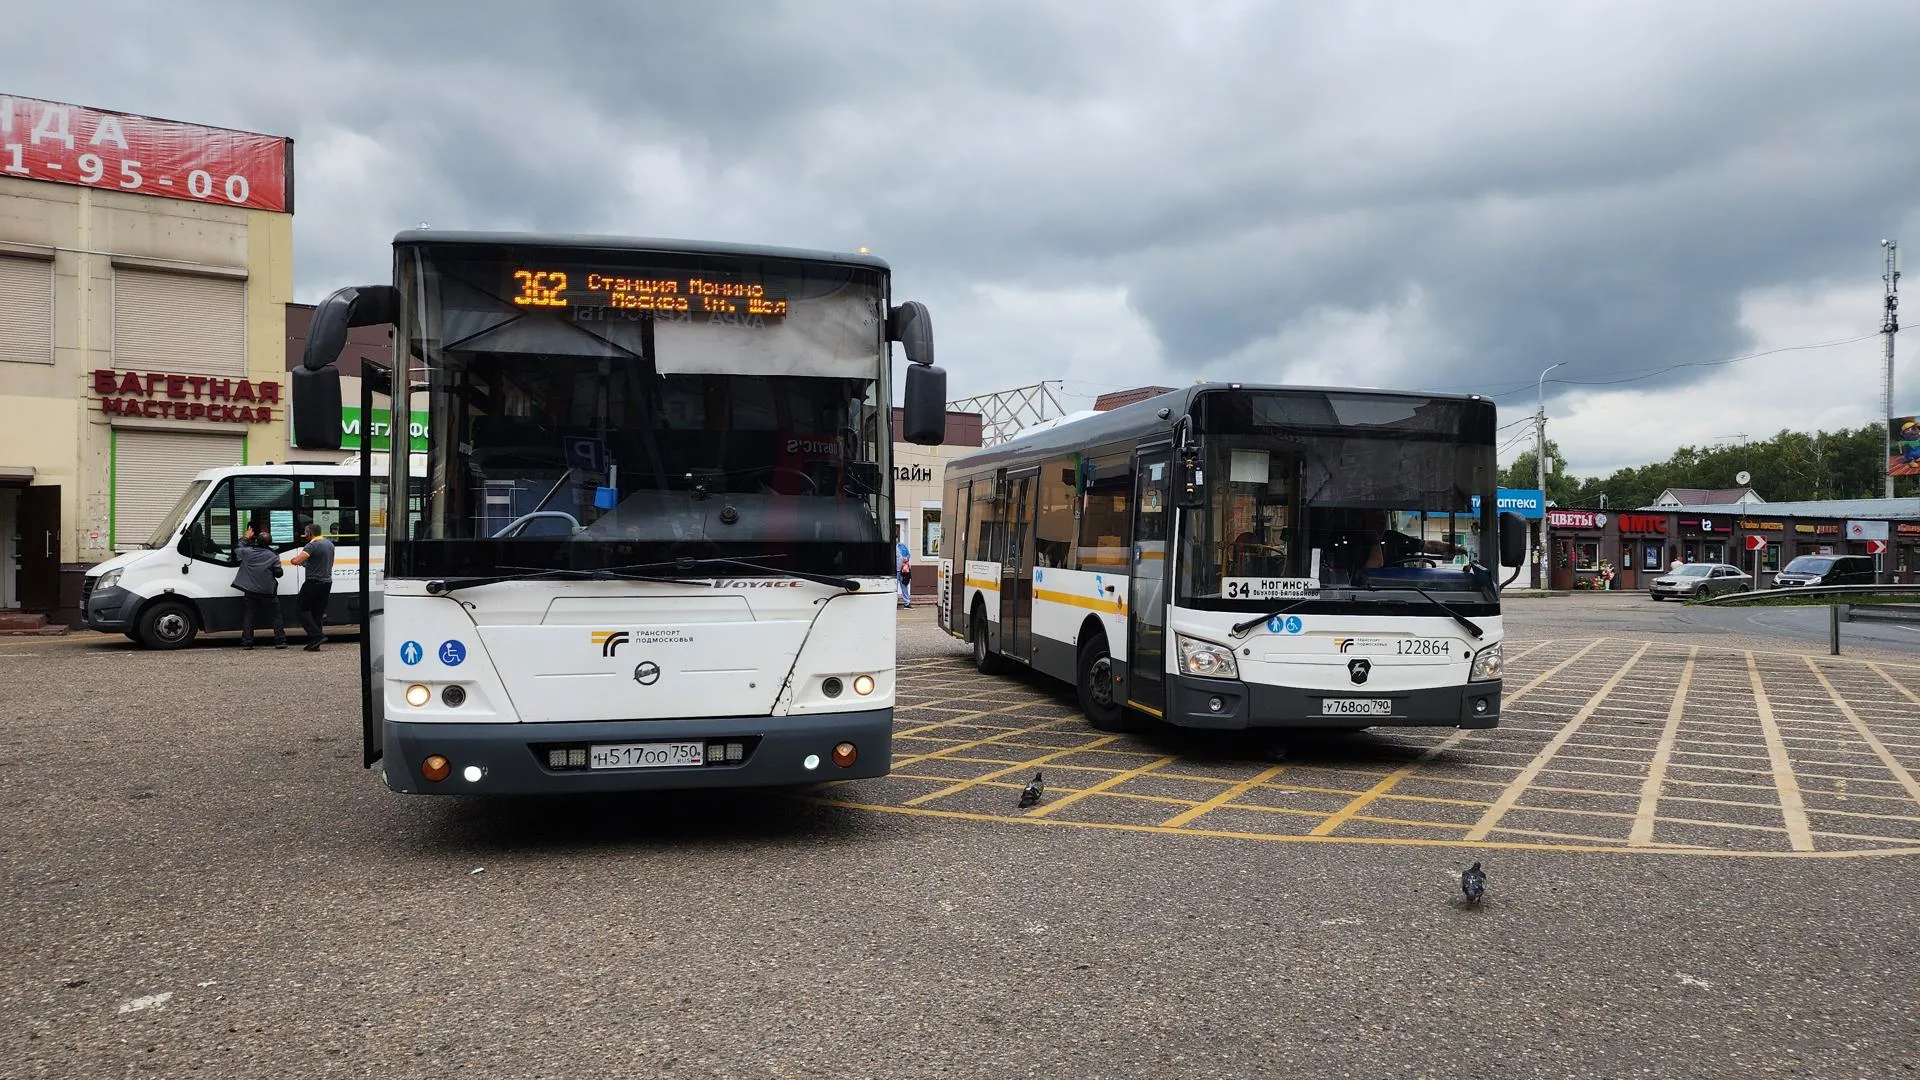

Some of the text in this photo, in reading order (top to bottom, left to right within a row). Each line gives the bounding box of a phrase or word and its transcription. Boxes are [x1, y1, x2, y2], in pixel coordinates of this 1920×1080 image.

[514, 270, 567, 306] 362
[587, 273, 764, 298] Станция Монино
[612, 292, 688, 311] Москва
[94, 369, 279, 405] БАГЕТНАЯ
[102, 395, 272, 423] МАСТЕРСКАЯ
[1497, 498, 1537, 509] аптека
[1550, 513, 1593, 527] ЦВЕТЫ
[1629, 514, 1668, 534] МТС
[1228, 581, 1250, 598] 34
[635, 636, 694, 644] ПОДМОСКОВЬЯ
[1396, 639, 1450, 655] 122864
[1372, 700, 1389, 710] 790
[671, 745, 698, 758] 750
